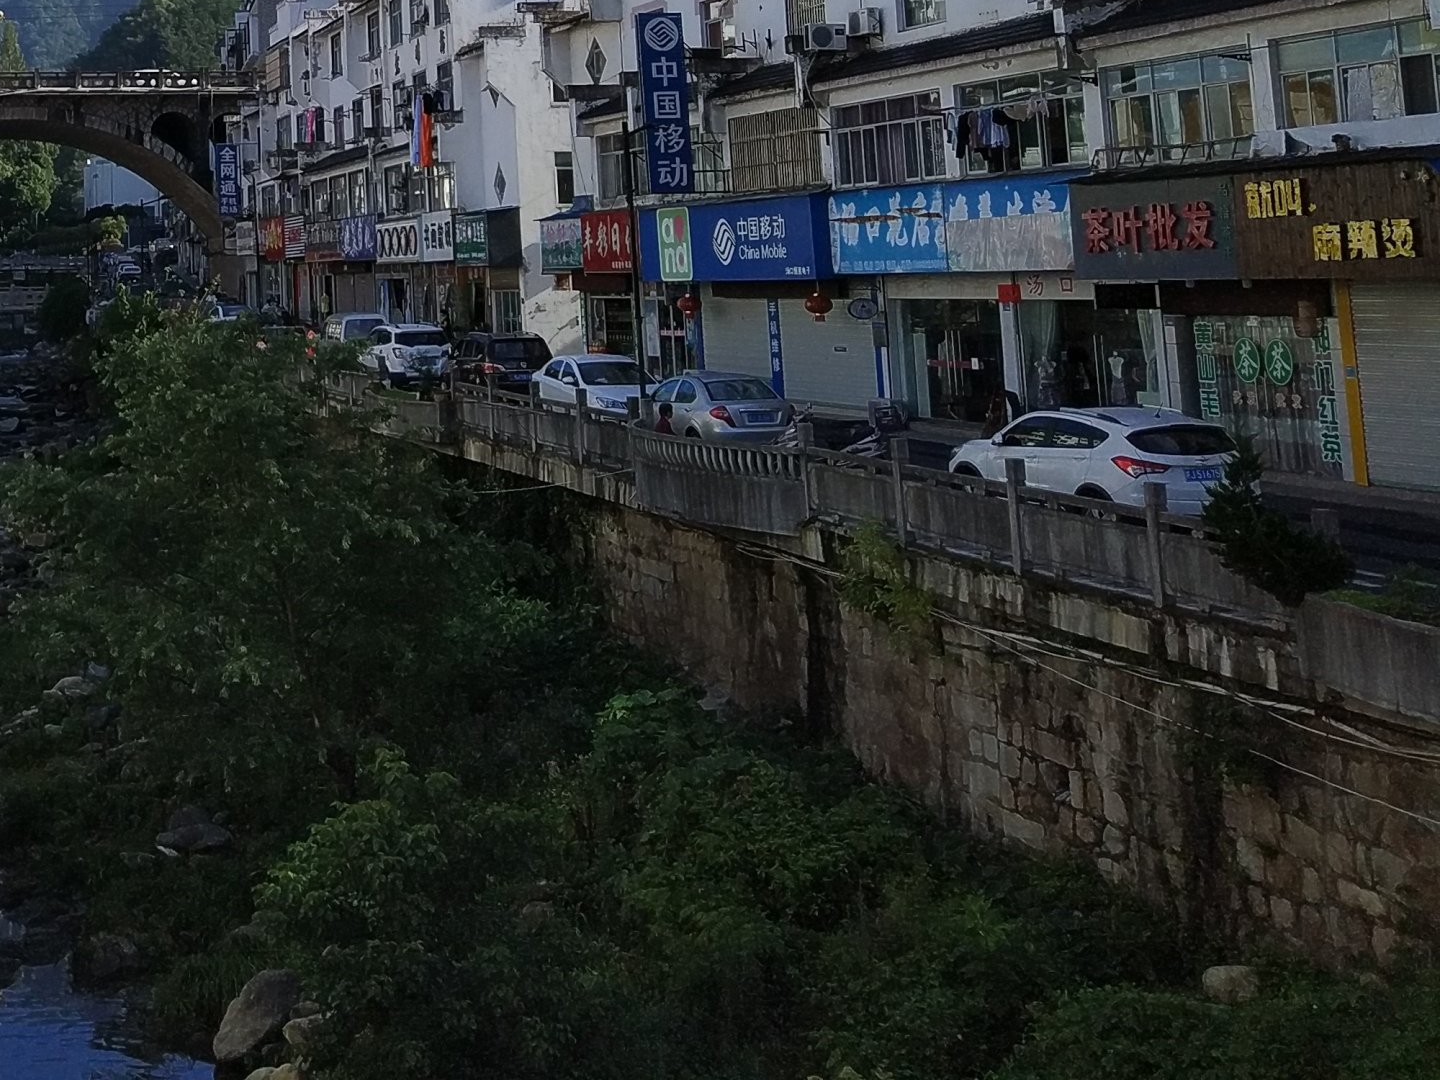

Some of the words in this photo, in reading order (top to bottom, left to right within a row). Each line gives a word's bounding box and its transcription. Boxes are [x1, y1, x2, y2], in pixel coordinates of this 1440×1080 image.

[651, 56, 689, 188] 中国移动
[219, 147, 237, 196] 全网通
[736, 213, 786, 242] 中国移动
[1081, 201, 1216, 255] 茶叶批发
[738, 245, 760, 260] China
[761, 242, 788, 259] Mobile
[1027, 273, 1074, 297] 汤口
[1236, 340, 1259, 377] 茶
[1269, 342, 1291, 379] 茶
